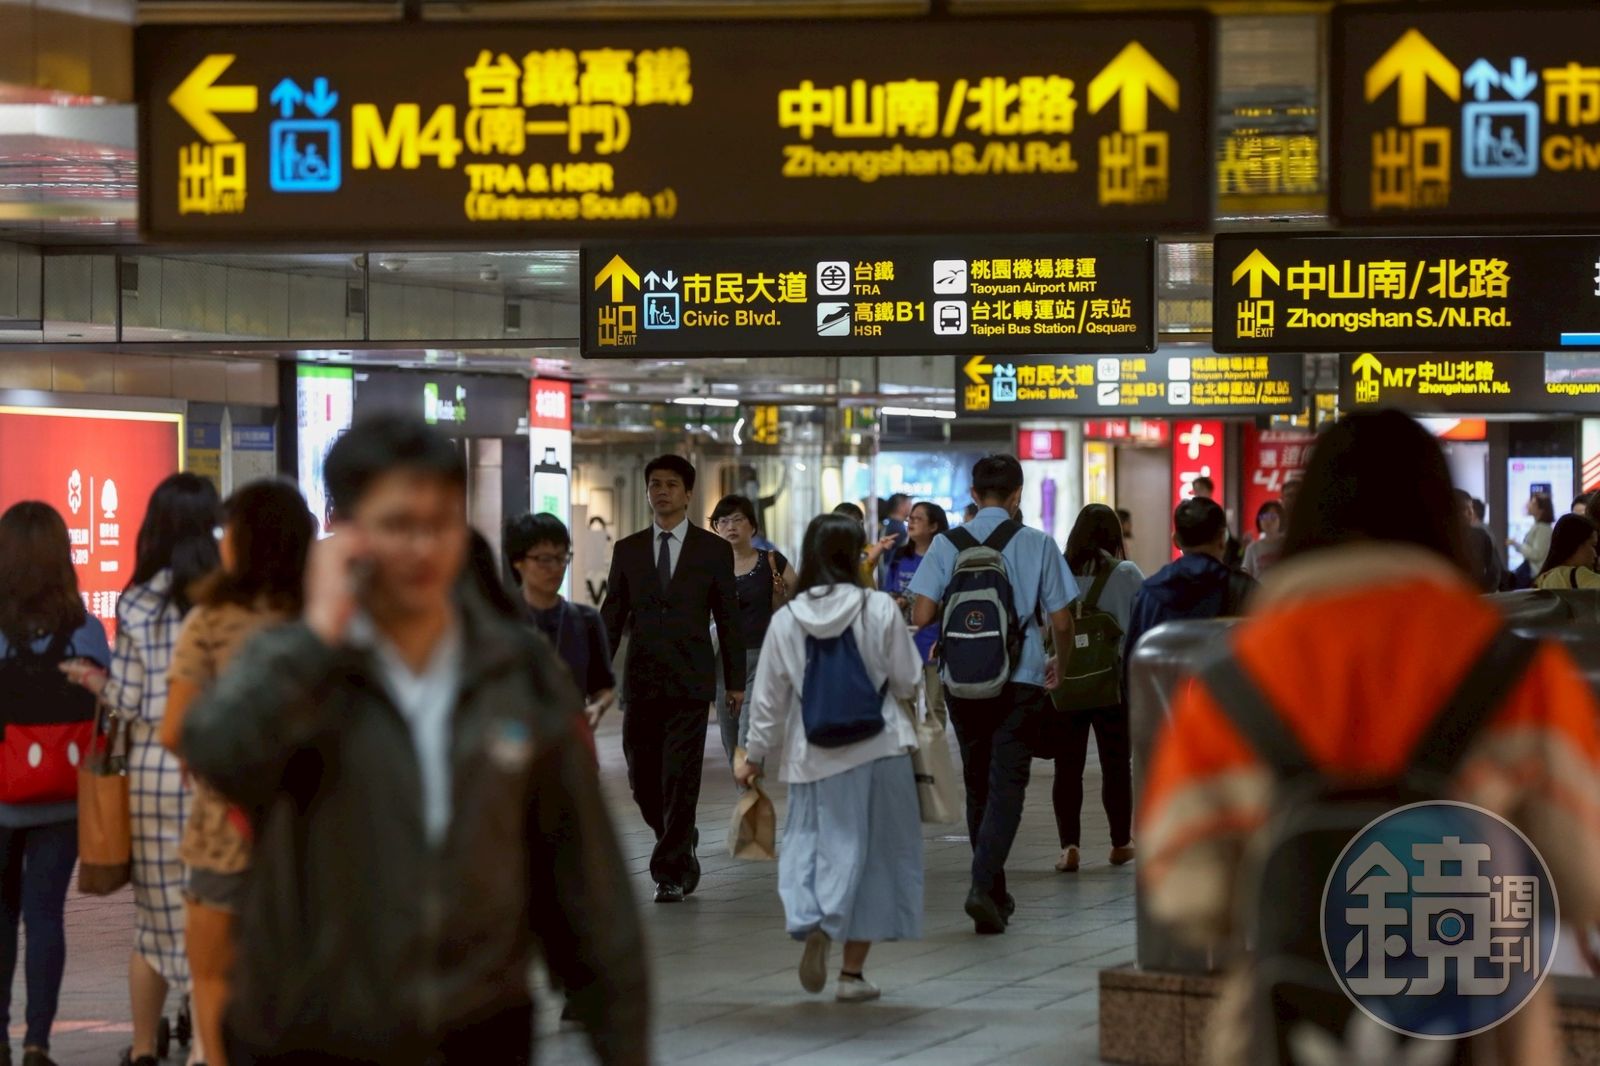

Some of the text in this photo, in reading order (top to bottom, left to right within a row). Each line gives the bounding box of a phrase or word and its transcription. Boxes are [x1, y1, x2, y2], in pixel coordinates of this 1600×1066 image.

[465, 49, 692, 105] 台鐵高鐵
[779, 75, 1076, 138] 中山南/北路
[351, 104, 461, 168] M4
[465, 105, 630, 155] (南一門)
[783, 144, 950, 182] Zhongshan
[1099, 131, 1168, 205] 出口
[1373, 127, 1450, 208] 出口
[179, 141, 246, 213] 出口
[464, 162, 613, 192] TRA & HSR
[580, 192, 651, 219] South
[854, 261, 894, 281] 台鐵
[971, 258, 1096, 279] 桃園機場捷運
[1287, 258, 1511, 300] 中山南/北路
[683, 272, 807, 303] 市民大道
[853, 284, 881, 295] TRA
[971, 281, 1097, 296] Taoyuan Airport MRT
[683, 310, 781, 327] Civic Blvd.
[854, 302, 925, 322] 高鐵B1
[1237, 300, 1274, 338] 出口
[1287, 308, 1412, 332] Zhongshan
[598, 304, 636, 346] 出口
[854, 325, 882, 336] HSR
[971, 324, 1005, 336] Taipei
[1008, 323, 1031, 334] Bus
[1256, 327, 1274, 338] EXIT
[617, 334, 637, 345] EXIT
[1017, 364, 1094, 386] 市民大道
[1383, 367, 1417, 388] M7
[1418, 361, 1495, 381] 中山北路
[1017, 386, 1079, 400] Civic Blvd.
[1418, 381, 1477, 396] Zhongshan
[1492, 381, 1511, 394] Rd.
